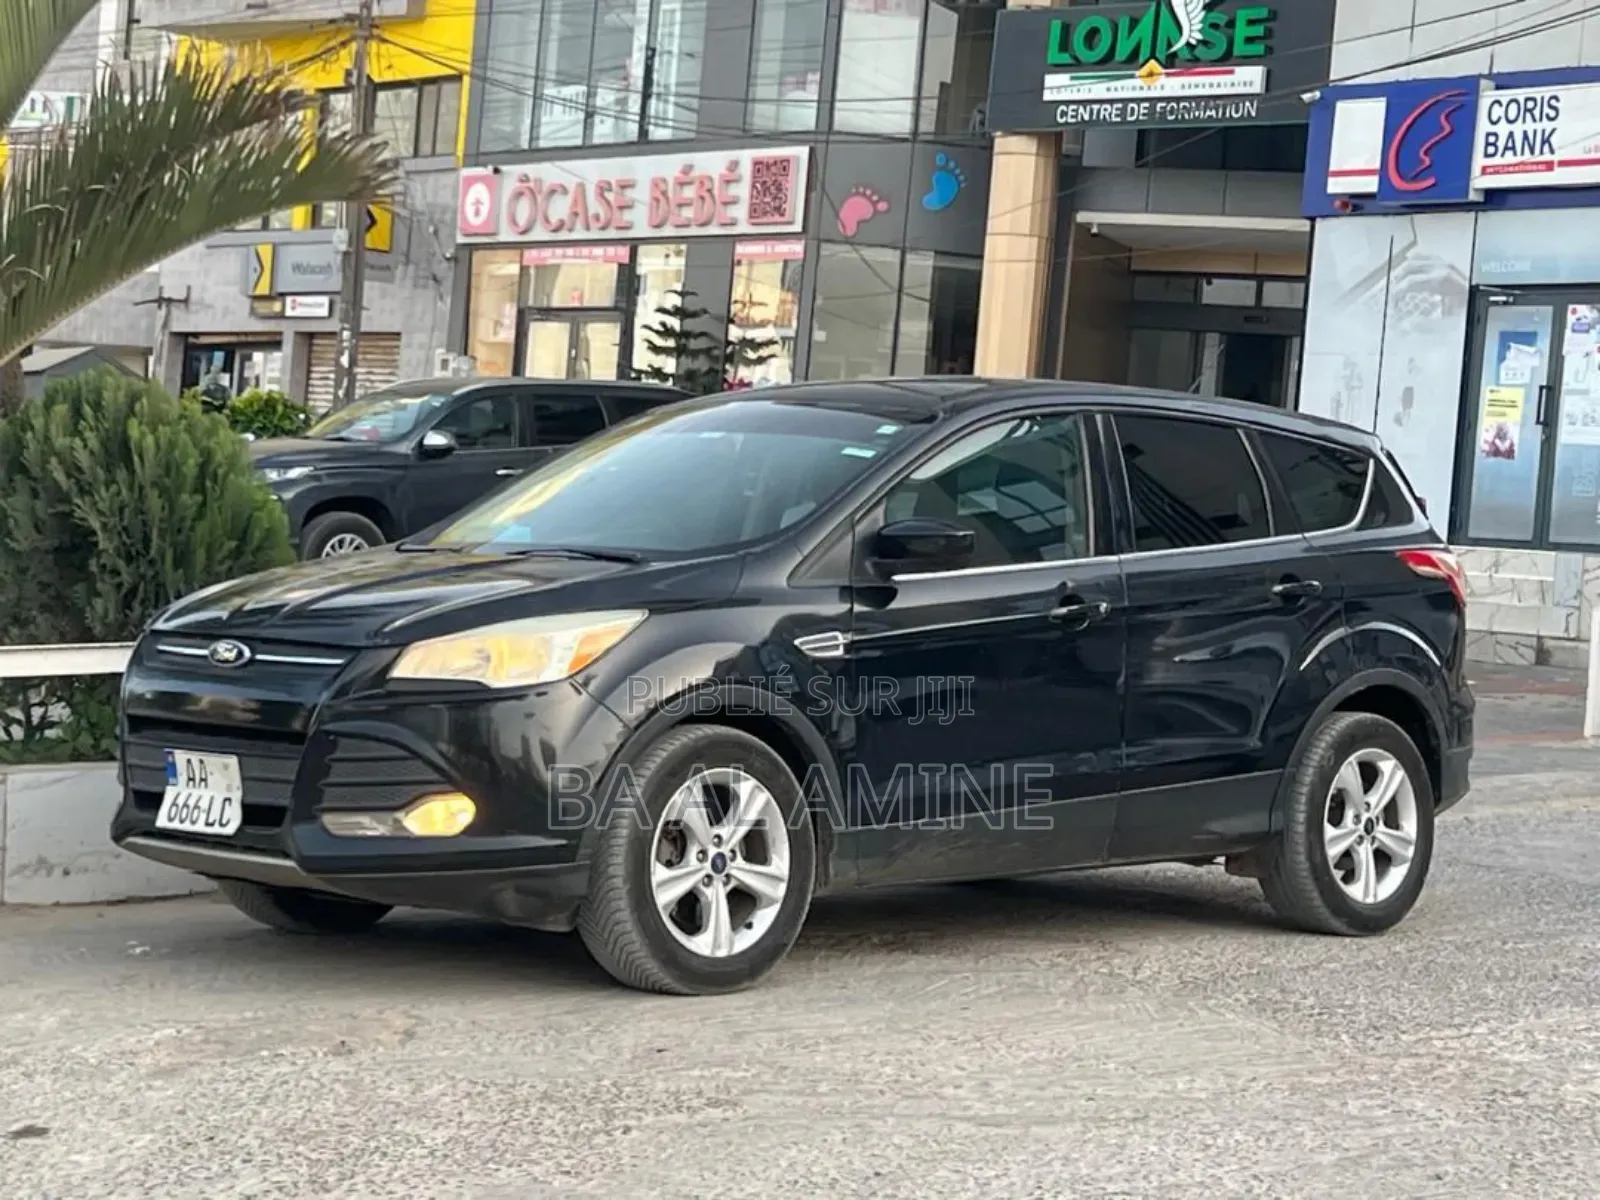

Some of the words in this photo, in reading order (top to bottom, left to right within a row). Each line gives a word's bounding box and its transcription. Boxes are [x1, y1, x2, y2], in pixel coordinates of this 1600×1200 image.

[1047, 0, 1268, 65] LONASE
[1056, 103, 1122, 123] CENTRE
[1127, 103, 1150, 121] DE
[1155, 99, 1258, 121] FORMATION
[1487, 95, 1560, 126] CORIS
[1483, 127, 1558, 159] BANK
[648, 159, 742, 229] BÉBÉ
[186, 758, 208, 789] AA
